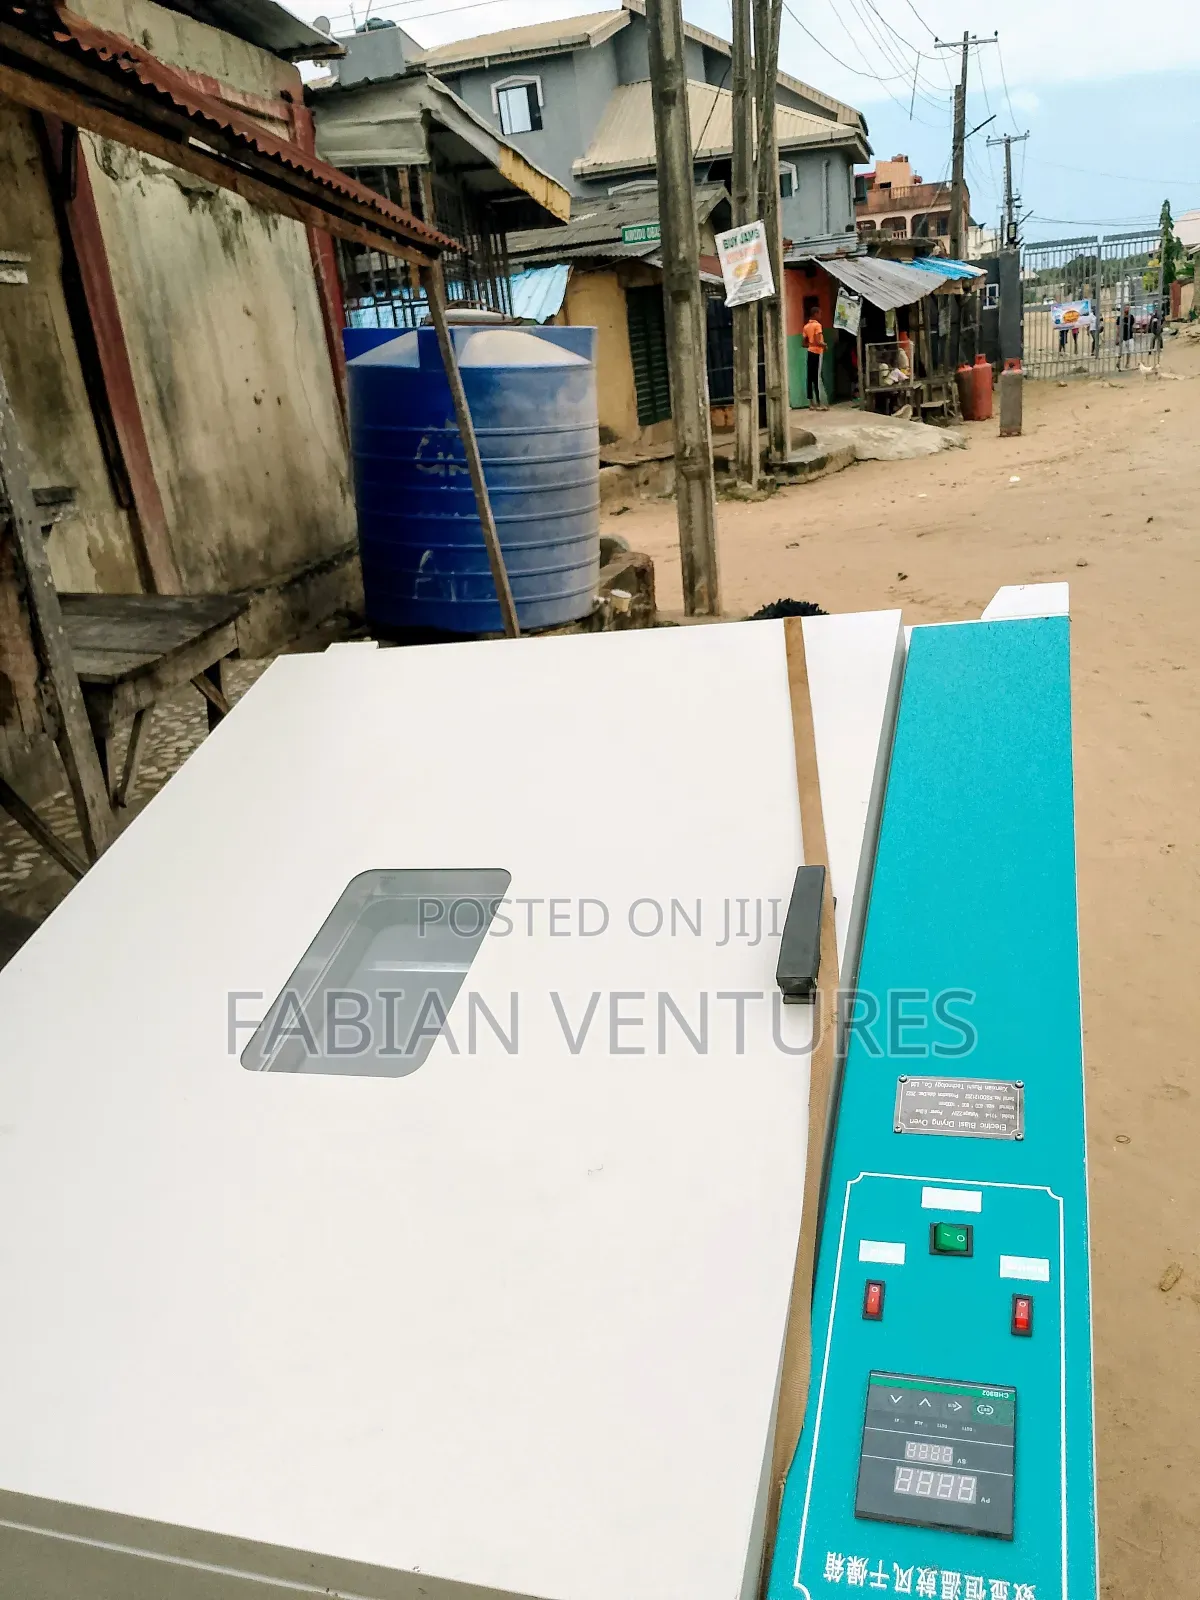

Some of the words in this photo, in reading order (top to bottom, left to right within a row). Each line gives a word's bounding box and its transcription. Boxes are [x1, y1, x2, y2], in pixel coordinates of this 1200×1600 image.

[935, 1081, 965, 1090] Technology
[910, 1118, 928, 1127] Oven
[932, 1118, 955, 1128] Drying
[959, 1121, 976, 1129] Blast
[980, 1122, 1007, 1131] Electric
[980, 1496, 991, 1504] PV
